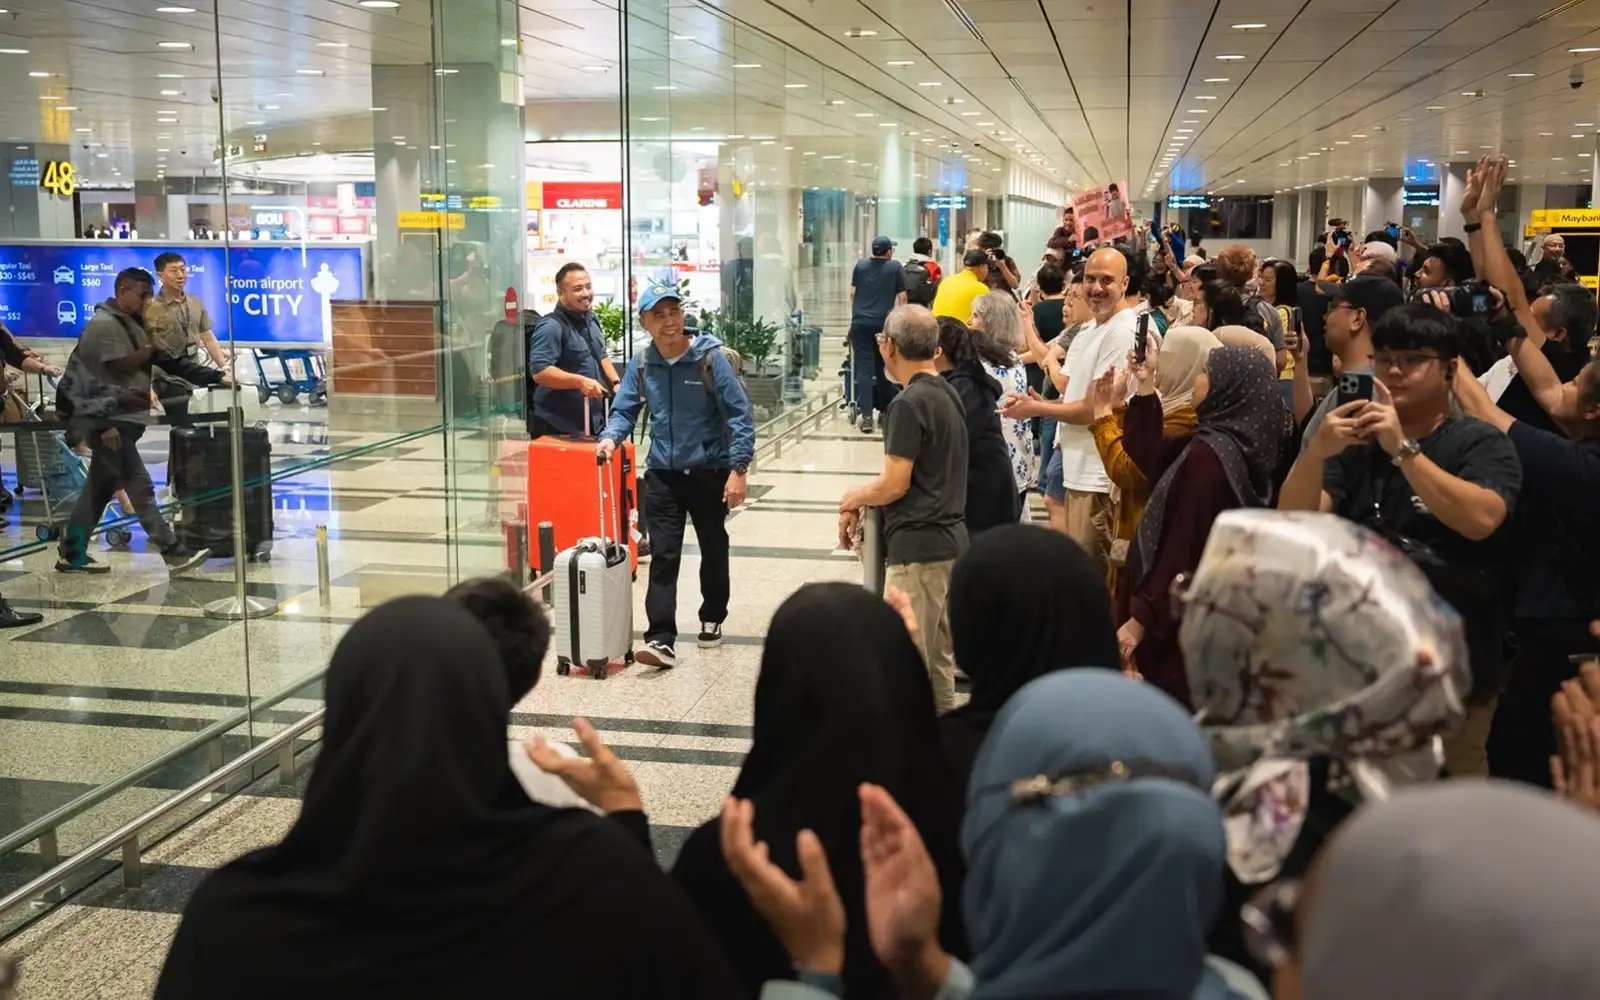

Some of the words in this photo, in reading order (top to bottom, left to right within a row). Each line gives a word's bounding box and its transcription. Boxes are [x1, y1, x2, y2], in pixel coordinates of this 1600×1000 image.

[44, 160, 75, 196] 48
[556, 198, 607, 209] CLARINS
[18, 262, 32, 270] Taxi
[80, 263, 99, 272] Large
[99, 262, 114, 271] Taxi
[191, 264, 205, 272] Taxi
[17, 271, 36, 281] S$45
[82, 278, 101, 288] S$60
[225, 275, 257, 290] From
[260, 276, 304, 292] airport
[244, 293, 304, 317] CITY
[7, 312, 21, 321] S$2
